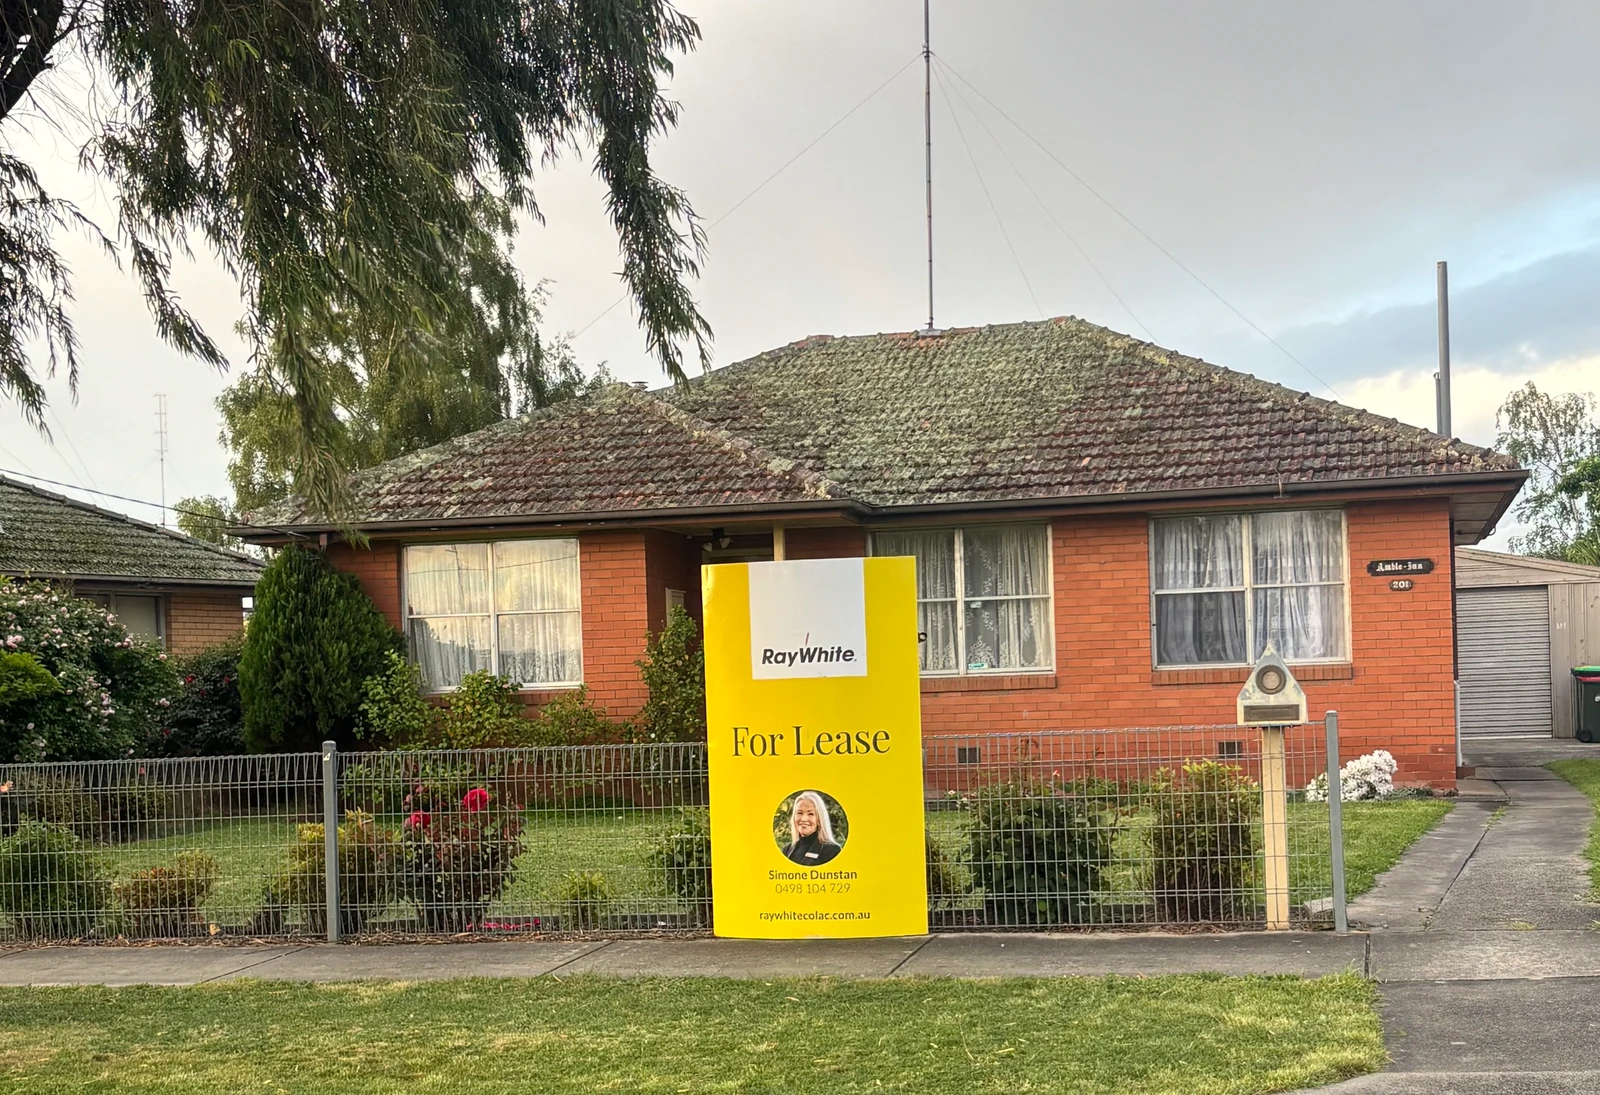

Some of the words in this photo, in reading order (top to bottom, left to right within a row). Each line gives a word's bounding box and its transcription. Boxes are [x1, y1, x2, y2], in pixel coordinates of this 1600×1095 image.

[1392, 580, 1409, 589] 201
[732, 726, 784, 757] For
[792, 725, 891, 756] Lease
[768, 869, 808, 880] Simone
[810, 870, 858, 880] Dunstan
[775, 883, 803, 894] 0498
[807, 883, 826, 894] 104
[829, 882, 851, 893] 729
[759, 910, 871, 922] raywhitecolac.com.au
